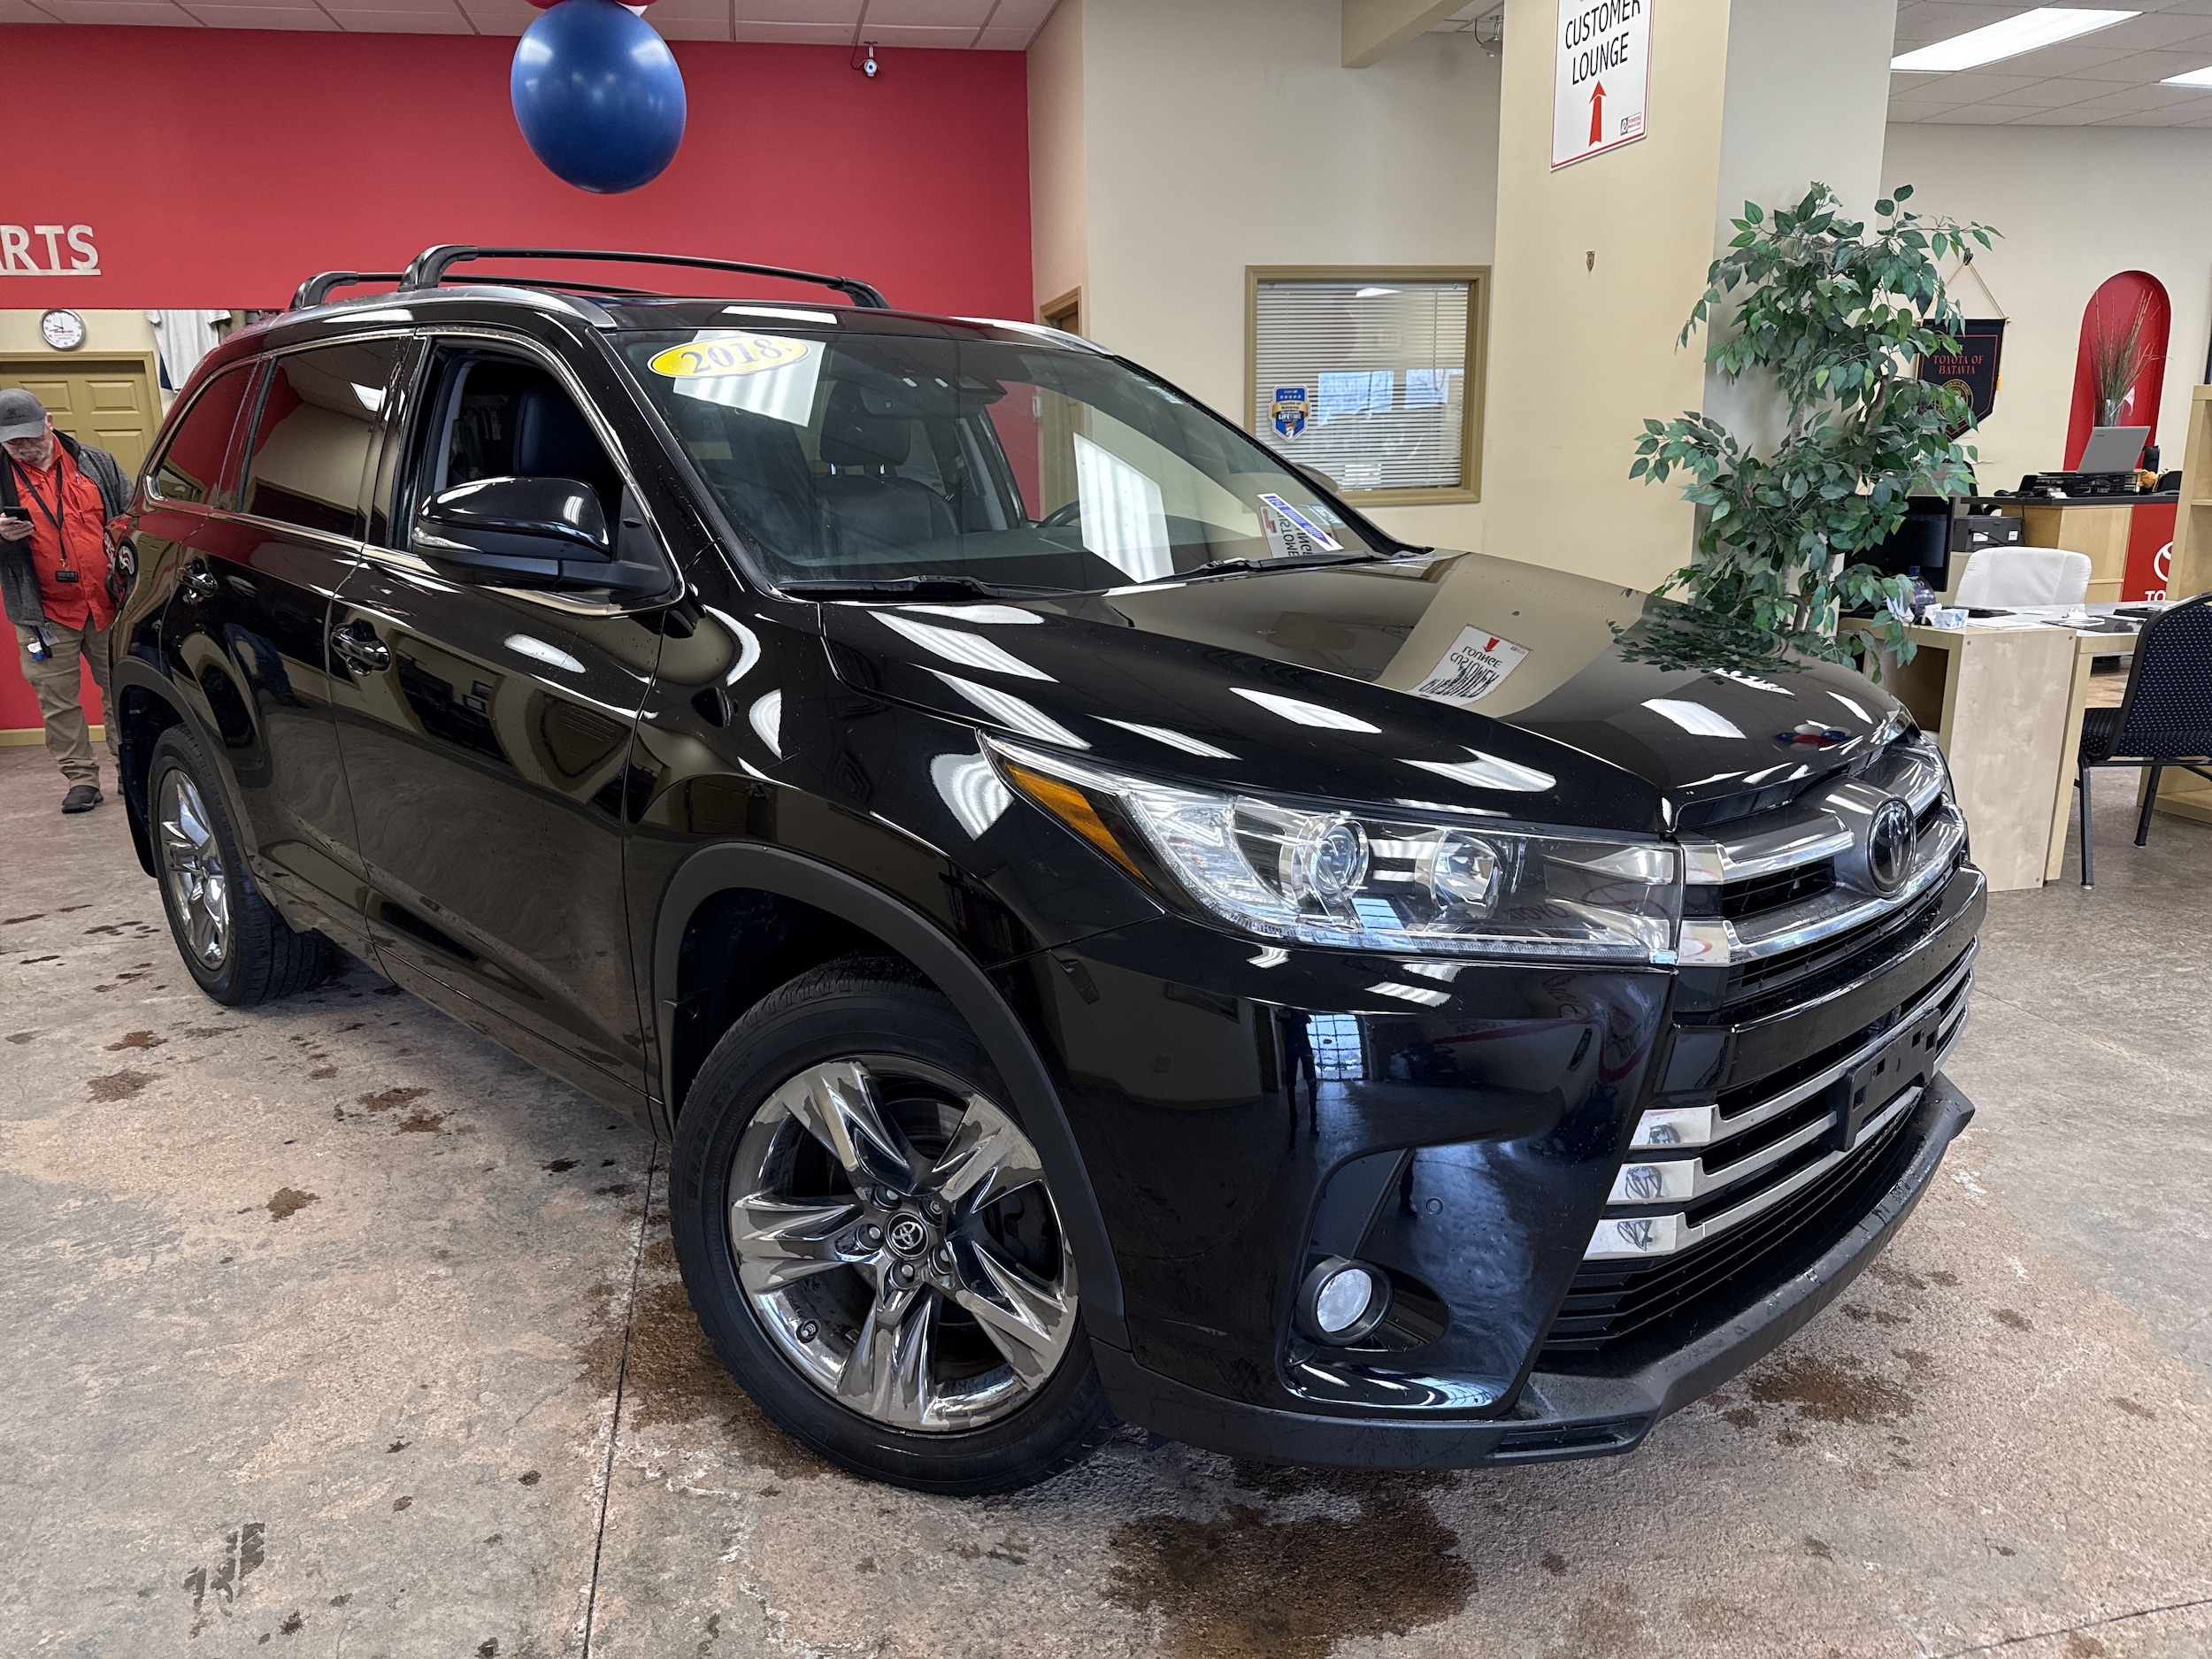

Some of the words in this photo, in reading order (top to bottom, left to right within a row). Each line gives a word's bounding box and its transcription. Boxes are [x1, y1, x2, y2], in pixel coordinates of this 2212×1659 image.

[1572, 32, 1629, 85] LOUNGE
[0, 224, 99, 271] RTS
[680, 338, 782, 374] 2018
[1932, 355, 1969, 365] TOYOTA
[1971, 355, 1984, 365] OF
[1938, 365, 1976, 375] BATAVIA
